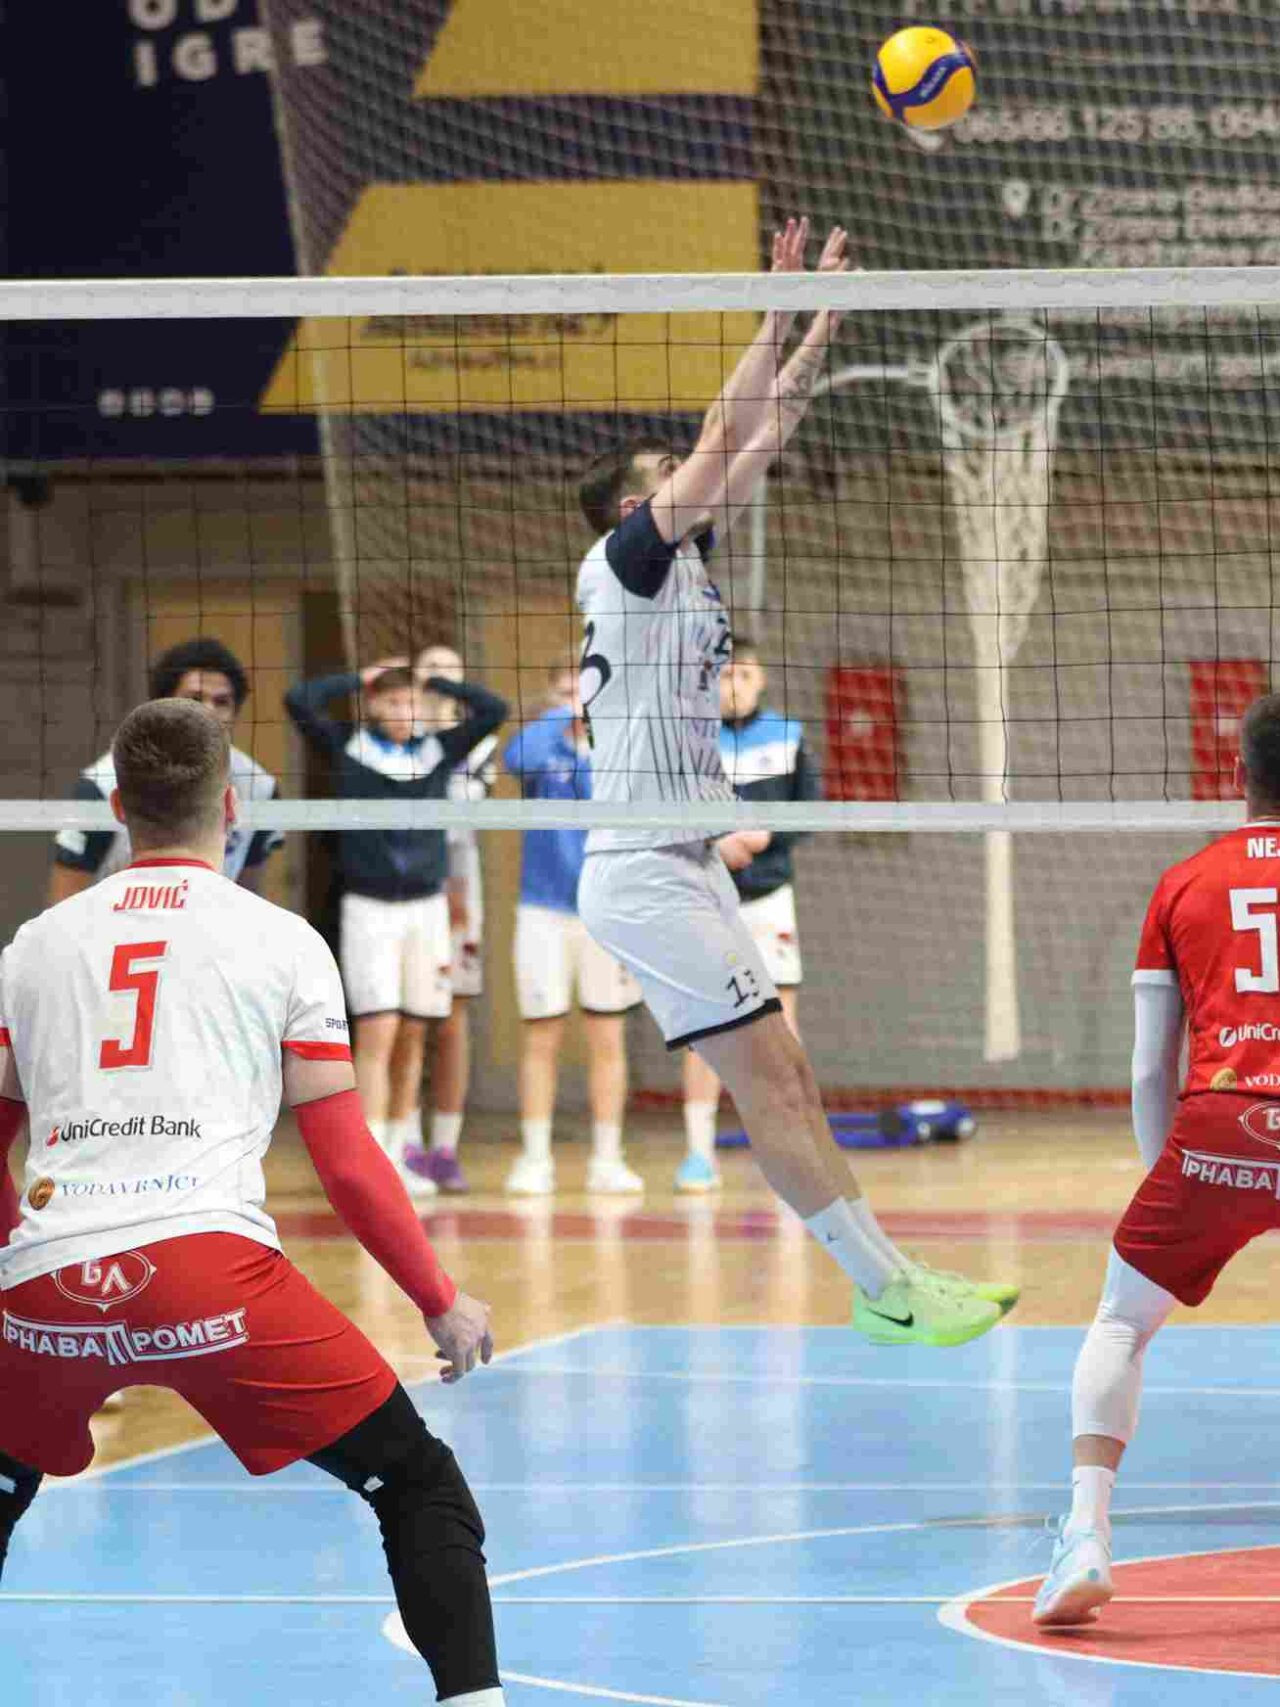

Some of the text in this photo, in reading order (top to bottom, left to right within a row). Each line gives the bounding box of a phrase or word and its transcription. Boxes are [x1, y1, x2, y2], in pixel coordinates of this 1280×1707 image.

[133, 17, 329, 86] IGRE
[112, 879, 190, 912] JOVIĆ
[99, 940, 168, 1070] 5
[60, 1114, 202, 1142] UniCredit Bank
